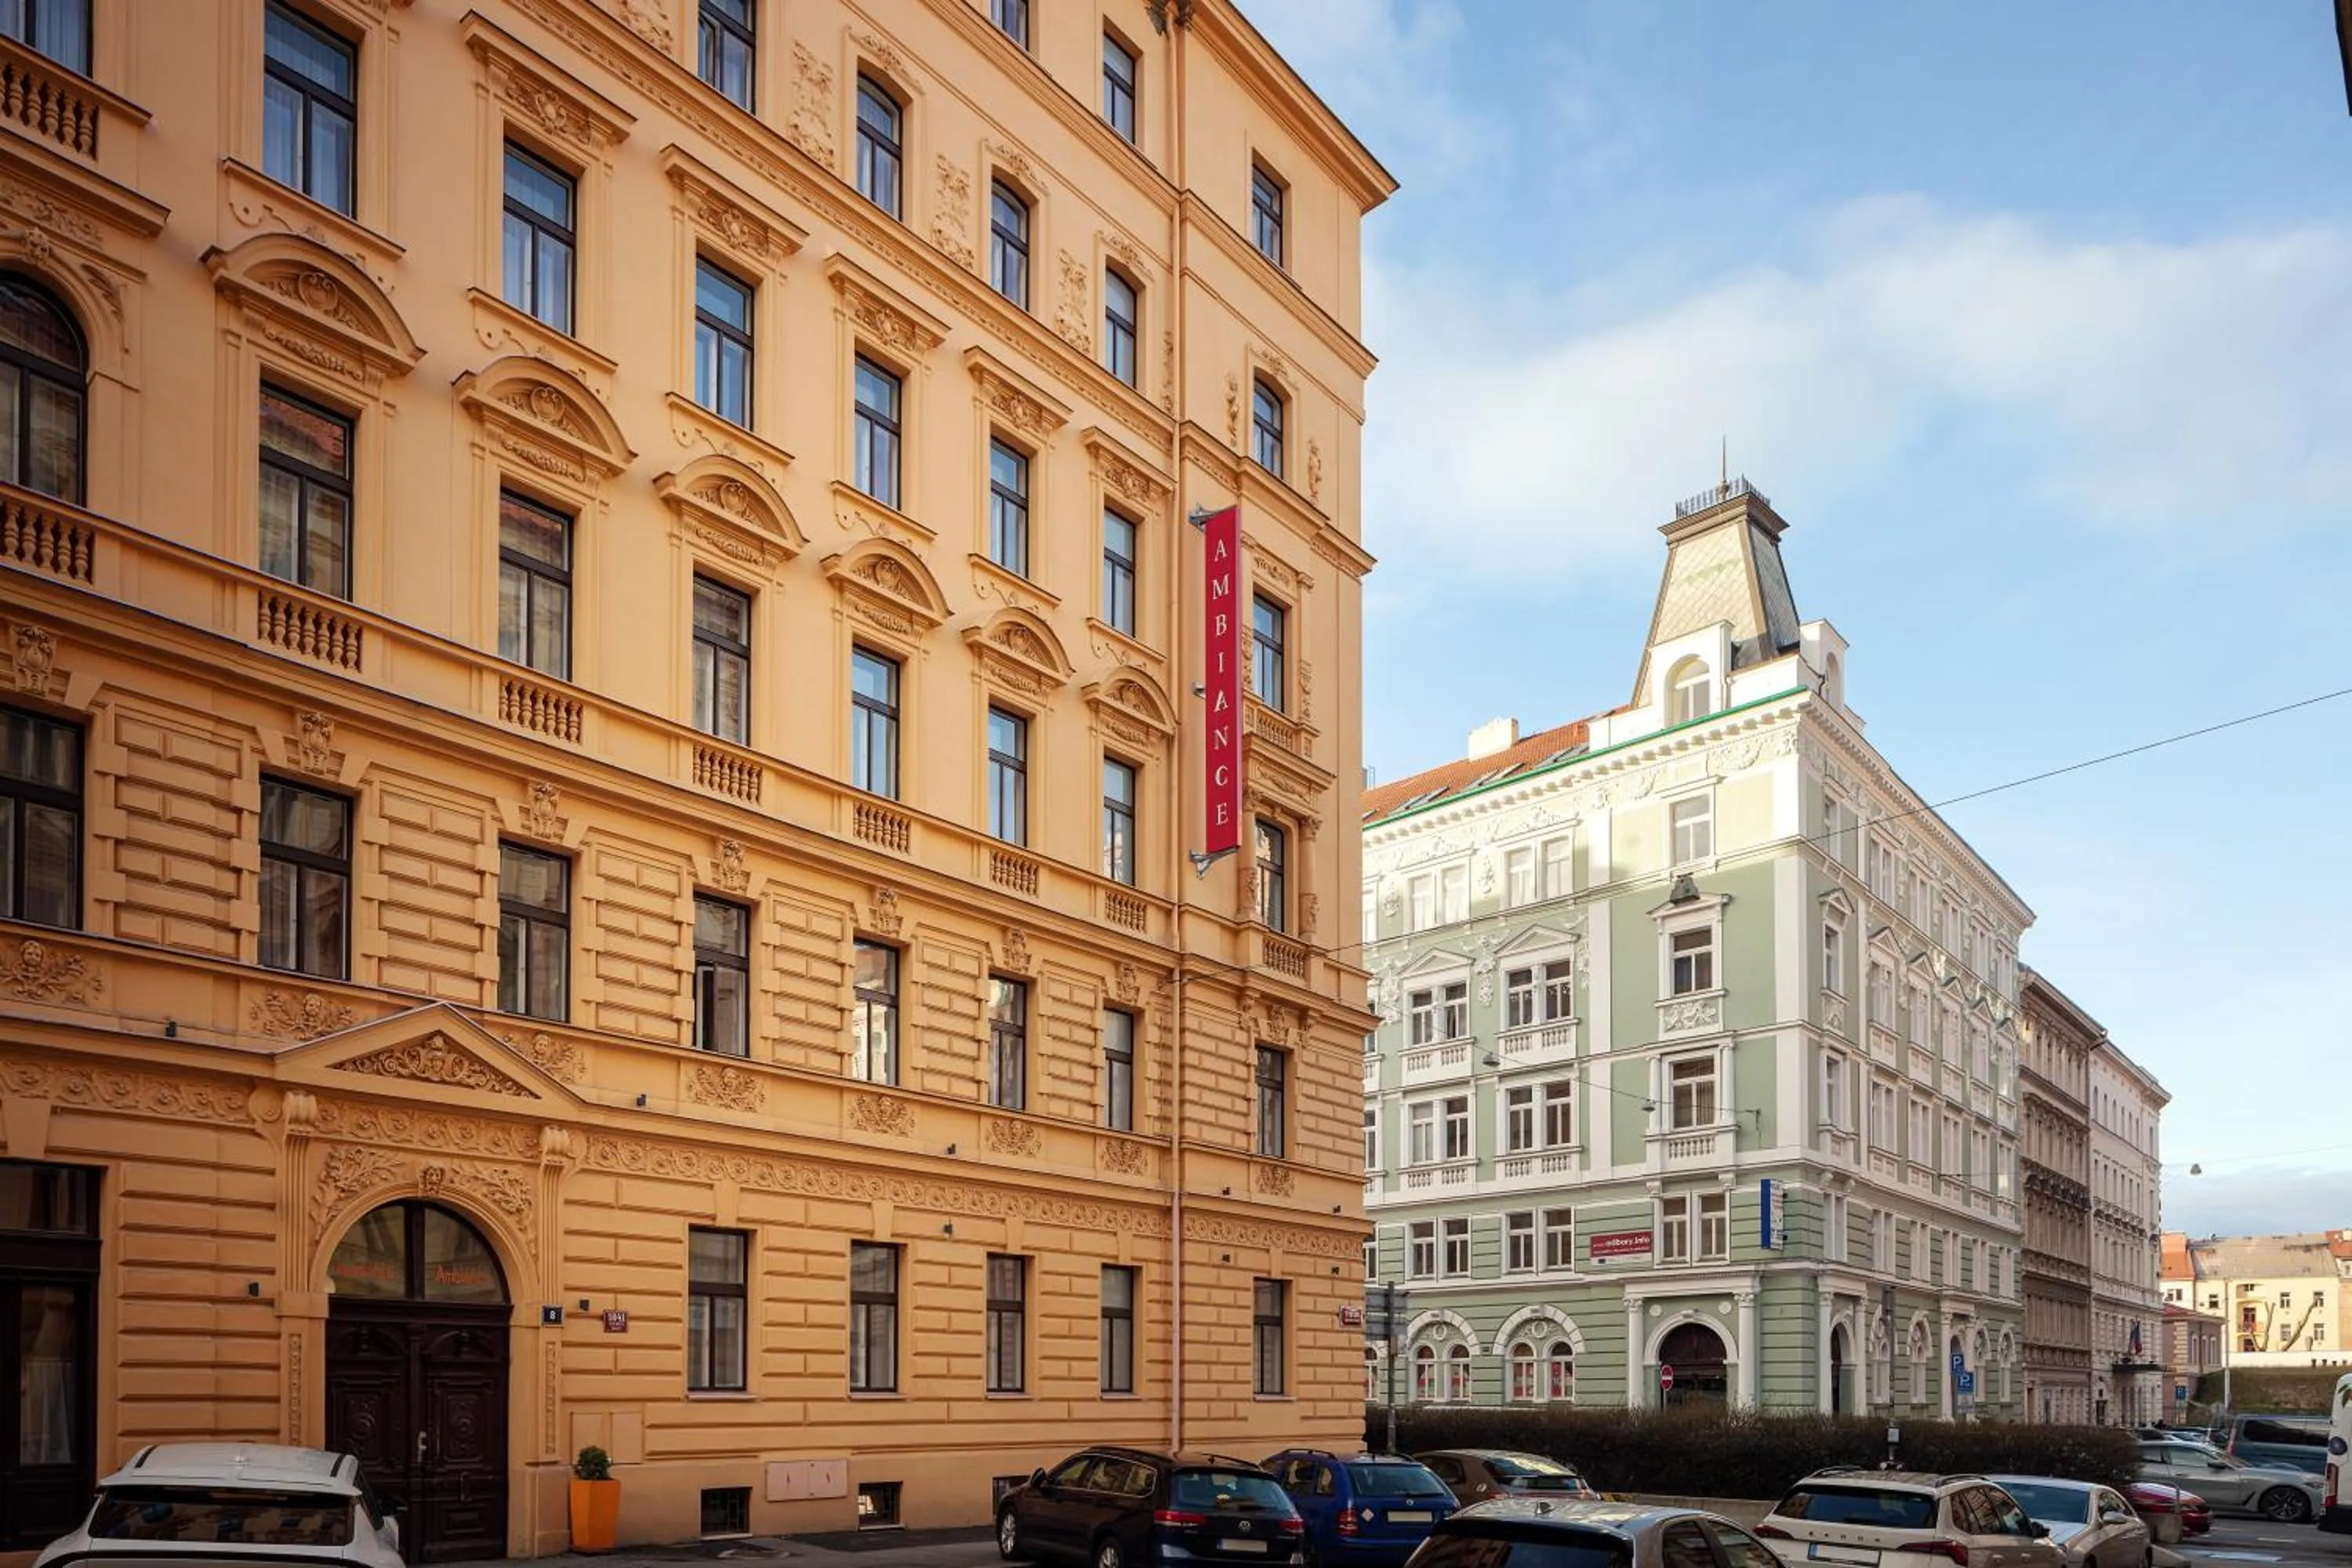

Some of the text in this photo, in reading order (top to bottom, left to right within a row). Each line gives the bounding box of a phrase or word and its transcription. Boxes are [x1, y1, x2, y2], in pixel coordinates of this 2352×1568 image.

[1212, 539, 1230, 826] AMBIANCE
[550, 1310, 556, 1320] 8
[1954, 1356, 1962, 1370] P
[1960, 1374, 1970, 1386] P
